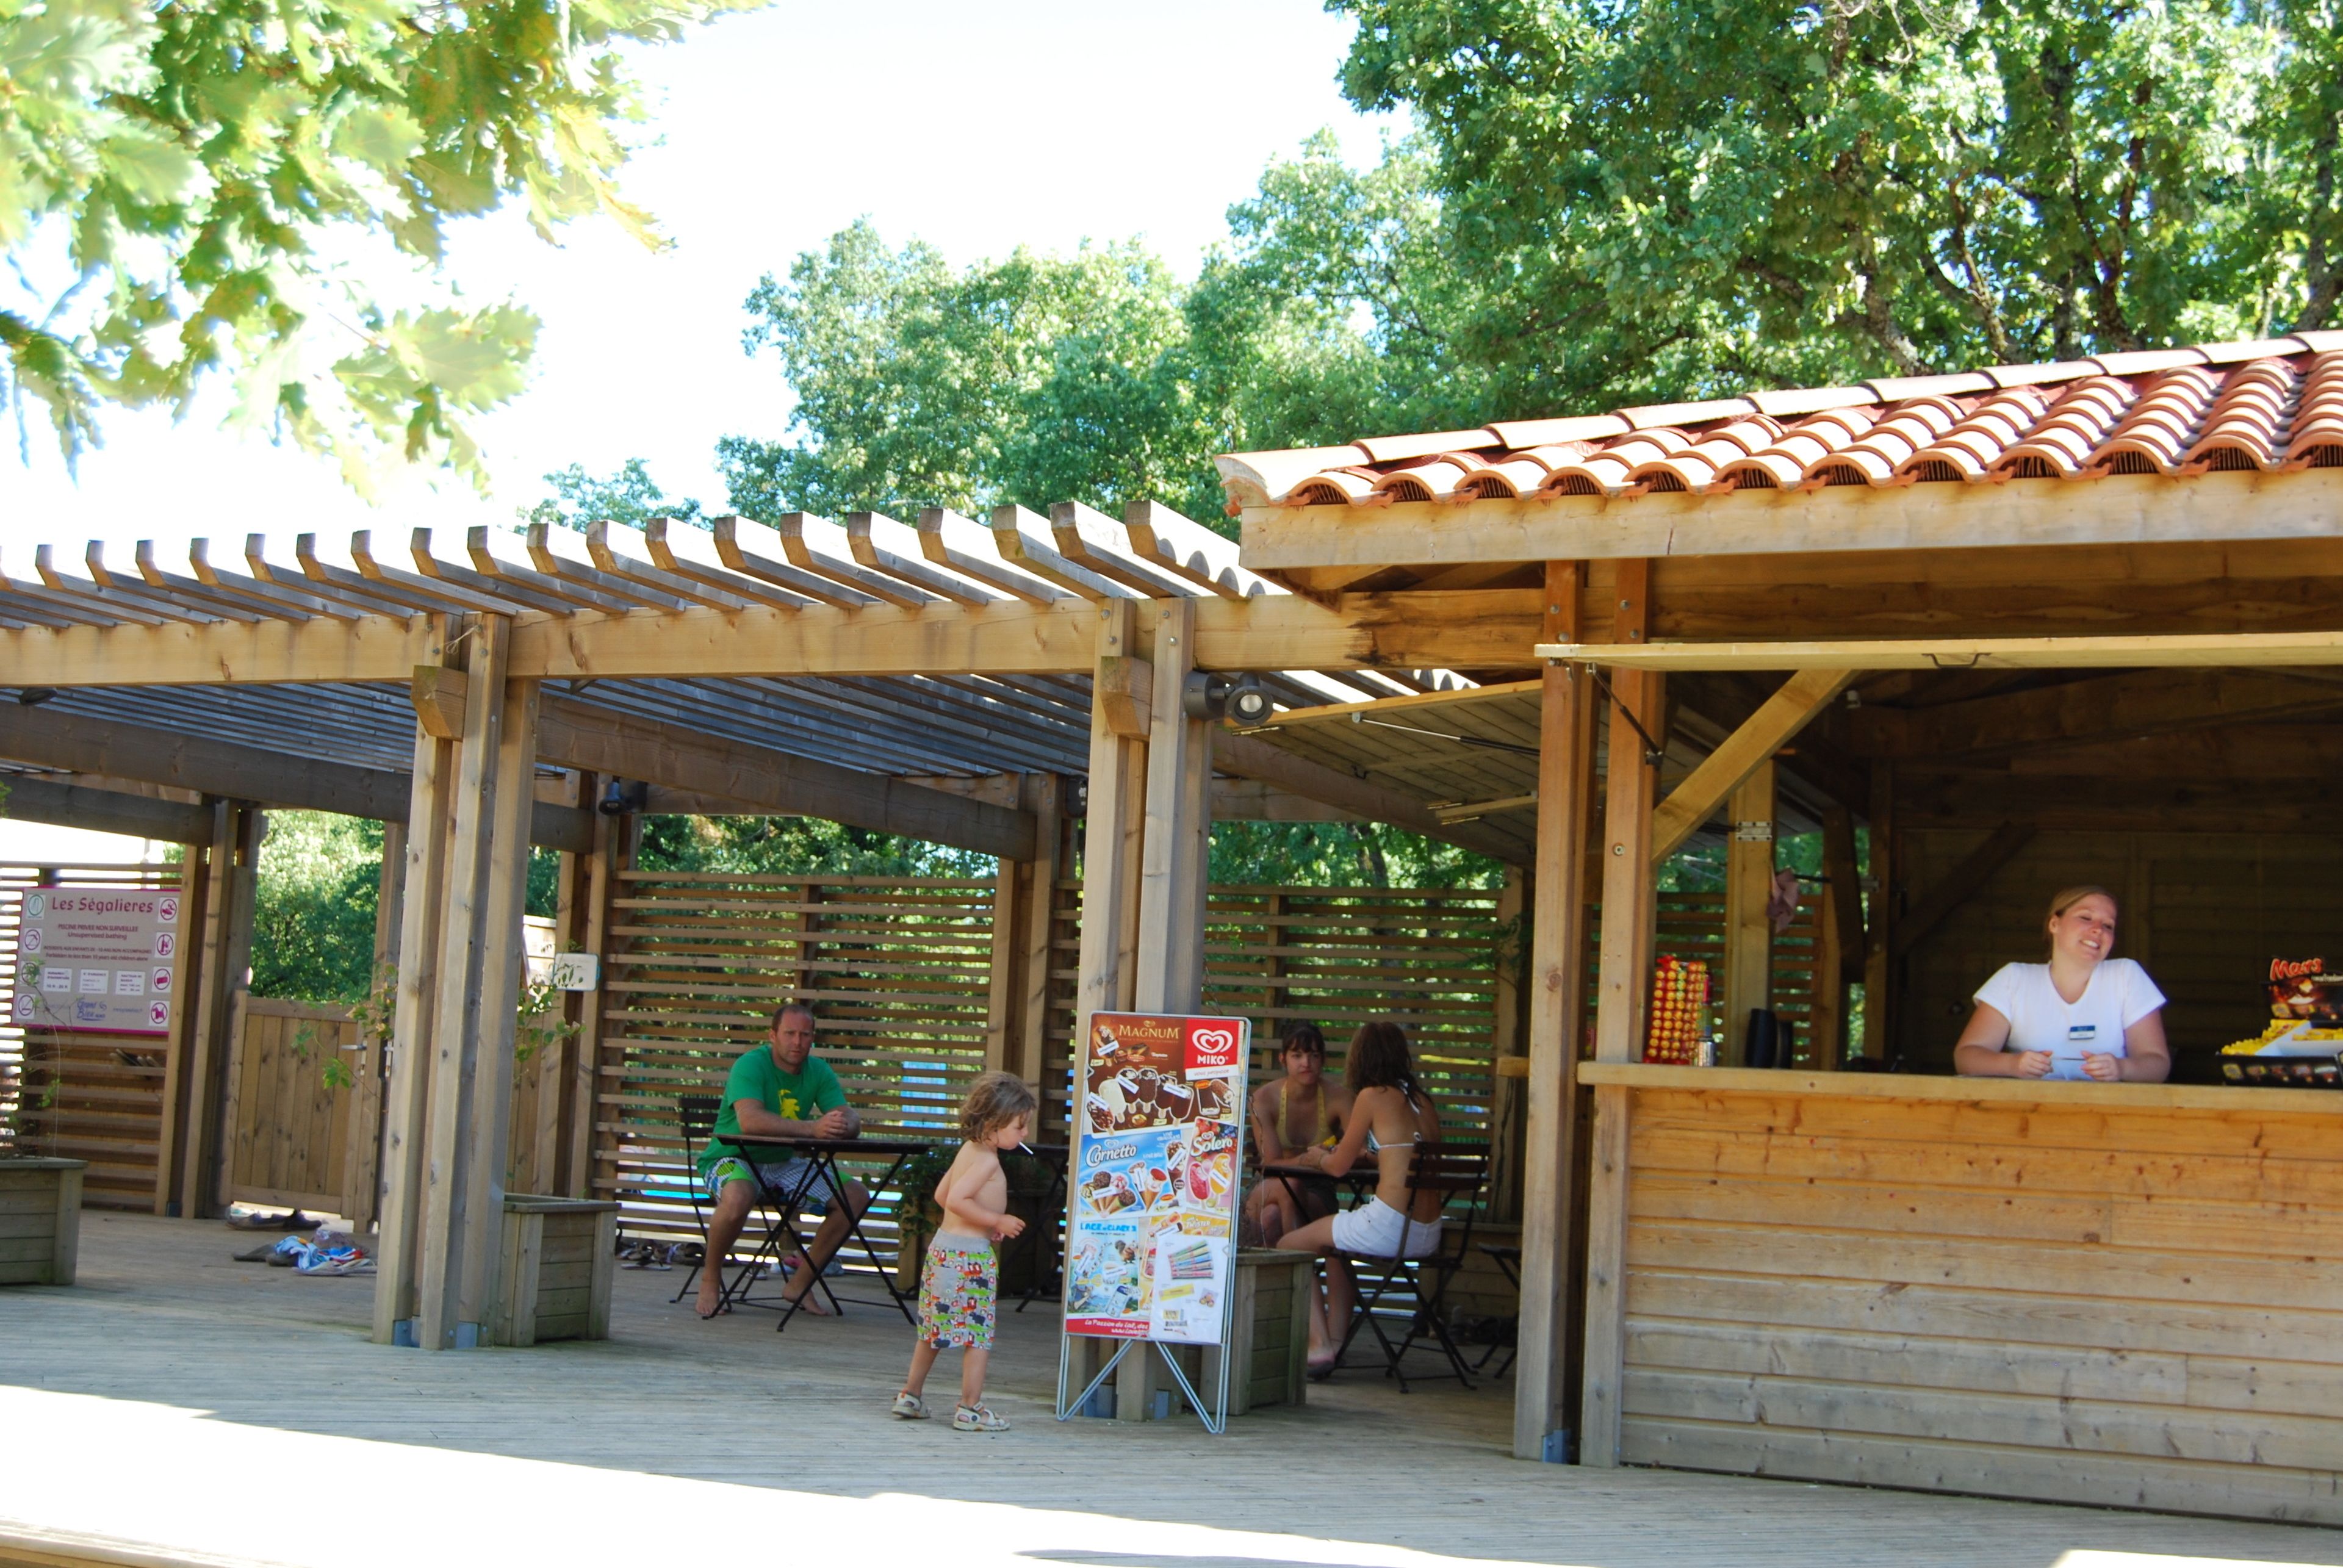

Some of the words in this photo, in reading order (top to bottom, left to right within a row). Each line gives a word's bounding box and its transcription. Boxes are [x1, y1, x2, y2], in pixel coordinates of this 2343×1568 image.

[52, 896, 74, 910] Les
[2270, 957, 2323, 982] Mars
[1118, 1024, 1181, 1040] MAGNUM
[1197, 1054, 1226, 1065] MIKO
[1085, 1144, 1137, 1167] Cornetto
[1190, 1137, 1233, 1157] Solero
